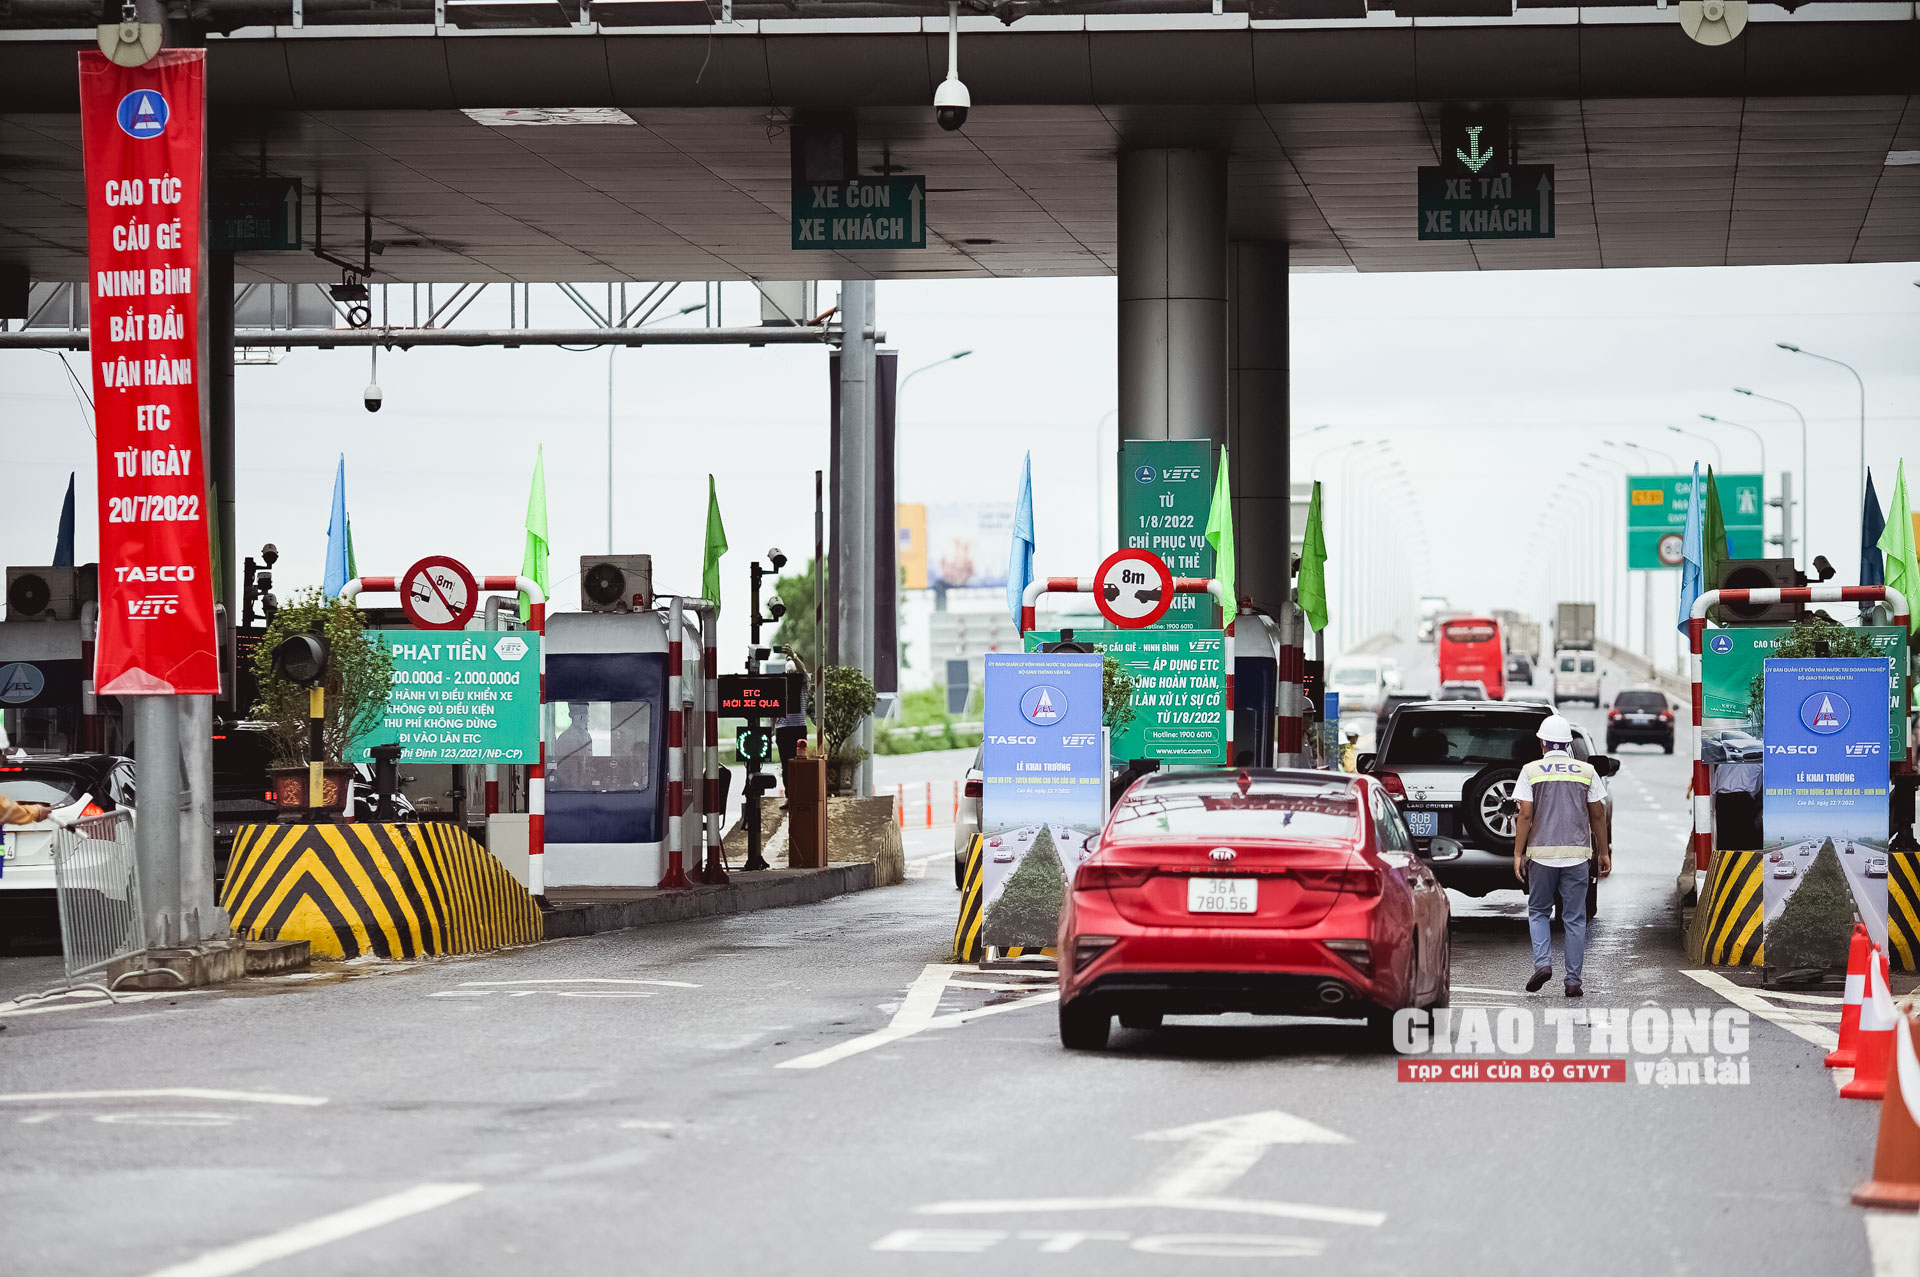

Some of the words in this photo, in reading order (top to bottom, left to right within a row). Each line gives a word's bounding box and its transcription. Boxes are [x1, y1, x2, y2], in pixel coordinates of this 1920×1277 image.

[106, 179, 144, 206] CAO
[148, 169, 182, 205] TỐC
[1444, 178, 1472, 200] XE
[812, 185, 839, 208] XE
[846, 185, 890, 208] CON
[1424, 210, 1452, 233] XE
[1459, 204, 1532, 233] KHÁCH
[112, 215, 150, 251] CẦU
[798, 218, 825, 241] XE
[832, 213, 904, 241] KHÁCH
[97, 269, 145, 298] NINH
[150, 263, 192, 296] BÌNH
[110, 305, 144, 342] BẮT
[148, 304, 184, 341] ĐẦU
[101, 355, 140, 393] VẬN
[144, 353, 192, 386] HÀNH
[136, 404, 171, 432] ETC
[114, 445, 138, 478] TỪ
[141, 444, 191, 477] NGÀY
[1162, 468, 1200, 479] VETC
[1158, 491, 1175, 508] TỪ
[108, 494, 200, 523] 20/7/2022
[1138, 514, 1194, 529] 1/8/2022
[1128, 532, 1150, 549] CHỈ
[1152, 535, 1186, 551] PHỤC
[1189, 535, 1206, 551] VỤ
[1178, 552, 1200, 568] THẺ
[114, 565, 195, 582] TASCO
[1122, 569, 1145, 585] 8m
[436, 574, 453, 590] 8m
[128, 598, 179, 616] VETC
[392, 644, 442, 664] PHẠT
[446, 637, 487, 661] TIỀN
[1143, 644, 1160, 652] NINH
[1162, 642, 1180, 652] BÌNH
[1188, 641, 1220, 650] VETC
[1754, 640, 1768, 648] CAO
[1152, 657, 1167, 671] ÁP
[1169, 660, 1198, 674] DỤNG
[1200, 660, 1220, 671] ETC
[454, 671, 520, 685] 2.000.000đ
[1158, 674, 1187, 688] HOÀN
[1190, 674, 1220, 690] TOÀN,
[395, 688, 426, 700] HÀNH
[428, 691, 438, 700] VI
[500, 691, 513, 700] XE
[1158, 690, 1174, 706] XỬ
[1175, 691, 1188, 706] LÝ
[1190, 693, 1204, 710] SỰ
[1206, 690, 1222, 706] CỐ
[386, 702, 426, 714] KHÔNG
[428, 702, 443, 714] ĐỦ
[472, 703, 495, 716] KIỆN
[759, 700, 780, 708] QUA
[384, 718, 402, 728] THU
[405, 716, 422, 728] PHÍ
[424, 716, 464, 728] KHÔNG
[466, 716, 497, 728] DỪNG
[1156, 710, 1172, 724] TỪ
[1173, 712, 1220, 724] 1/8/2022
[399, 733, 410, 743] ĐI
[412, 731, 437, 743] VÀO
[440, 731, 460, 743] LÀN
[463, 734, 482, 743] ETC
[988, 736, 1037, 745] TASCO
[1062, 735, 1096, 746] VETC
[415, 748, 437, 759] Định
[440, 748, 523, 760] 123/2021/NĐ-CP)
[1766, 745, 1818, 754] TASCO
[1845, 744, 1880, 755] VETC
[1025, 762, 1042, 771] KHAI
[1538, 764, 1582, 774] VEC
[1806, 774, 1824, 782] KHAI
[1410, 813, 1430, 823] 80B
[1409, 824, 1432, 834] 6157
[1209, 880, 1236, 894] 36A
[1197, 896, 1248, 910] 780.56
[869, 1228, 1328, 1257] ETC
